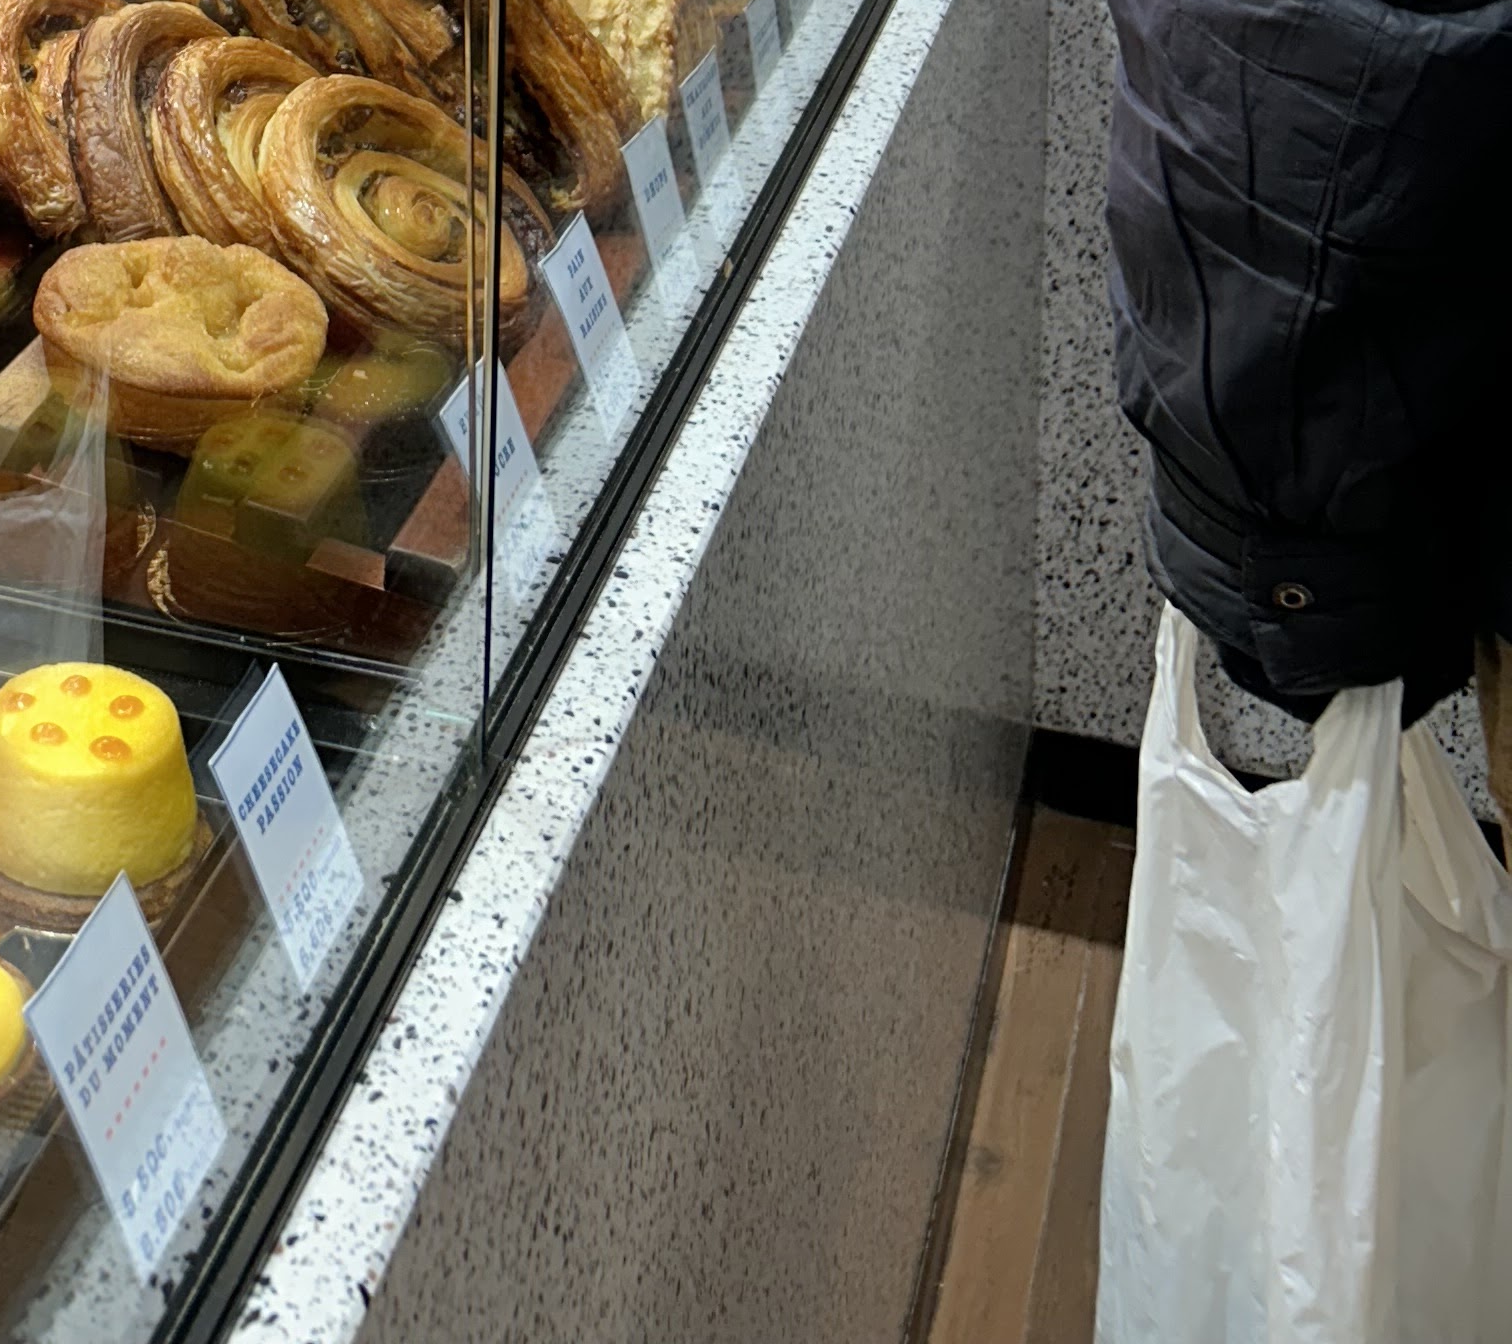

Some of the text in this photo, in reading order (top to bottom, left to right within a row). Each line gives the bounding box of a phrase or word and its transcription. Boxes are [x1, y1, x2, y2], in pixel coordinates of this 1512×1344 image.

[567, 247, 585, 279] PAIN
[578, 274, 594, 304] AUX
[579, 292, 608, 340] RAISINS
[238, 717, 302, 822] CHEESECAKE
[256, 753, 304, 836] PASSION
[63, 943, 152, 1086] PÂTISSERIES
[78, 972, 162, 1111] DU MOMENT
